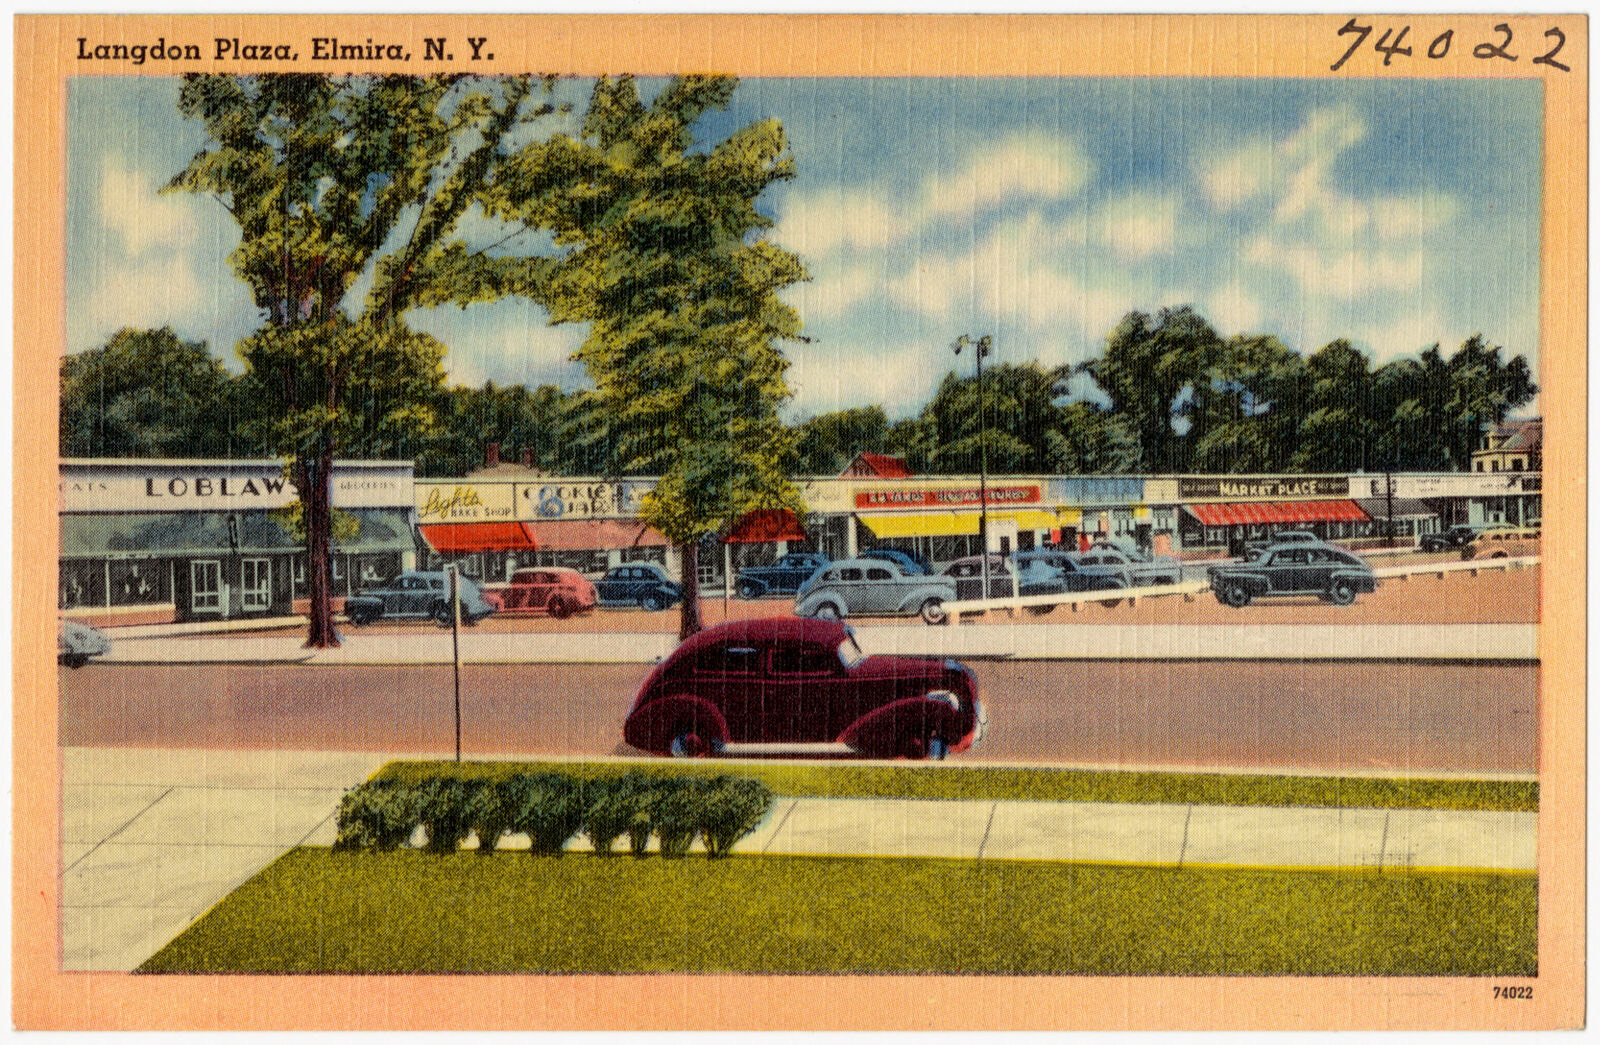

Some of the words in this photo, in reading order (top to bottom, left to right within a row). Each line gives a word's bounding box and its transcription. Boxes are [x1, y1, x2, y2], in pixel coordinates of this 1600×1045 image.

[1330, 18, 1571, 72] 74022
[1220, 481, 1273, 496] MARKET
[1278, 480, 1317, 496] PLACE
